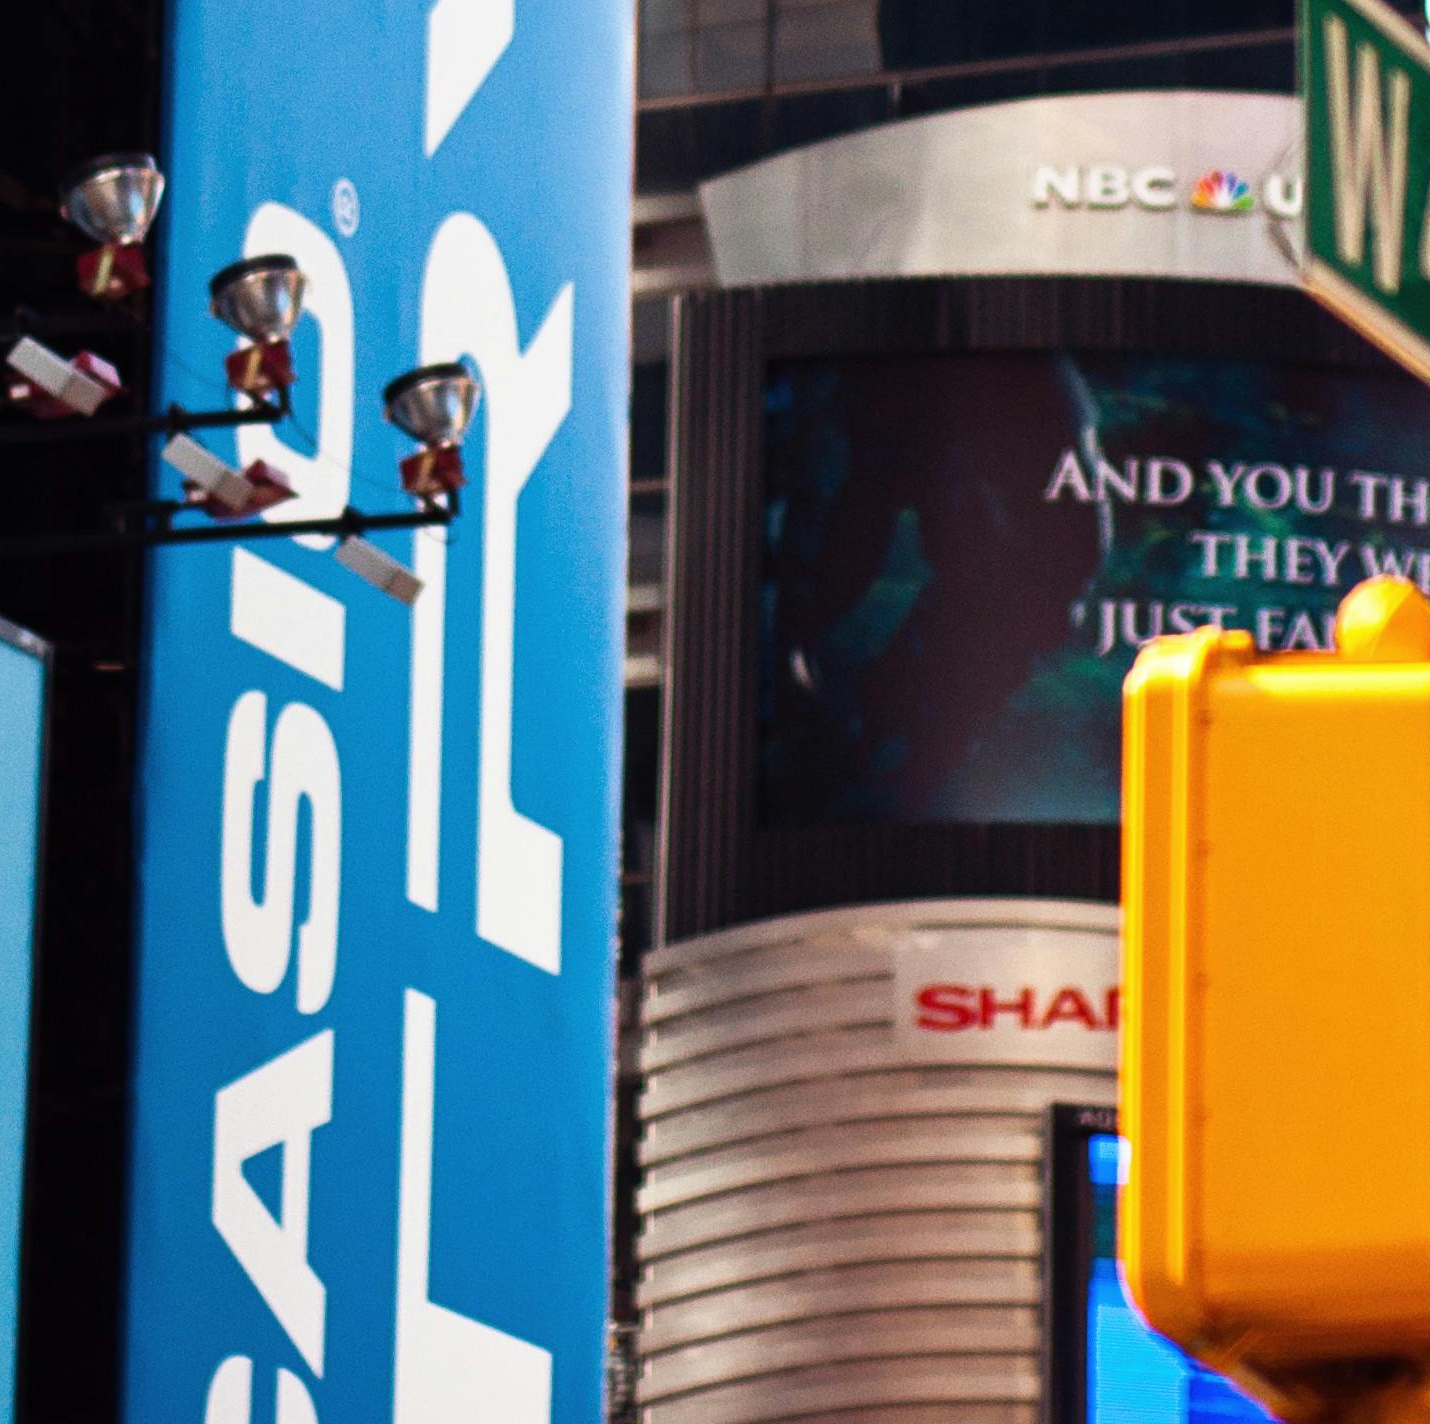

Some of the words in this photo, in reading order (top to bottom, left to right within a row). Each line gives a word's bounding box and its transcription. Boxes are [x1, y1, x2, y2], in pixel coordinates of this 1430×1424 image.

[1324, 15, 1410, 293] W
[1034, 165, 1176, 208] NBC
[1046, 449, 1193, 506] AND
[1207, 460, 1335, 513] YOU
[1191, 530, 1349, 585] THEY
